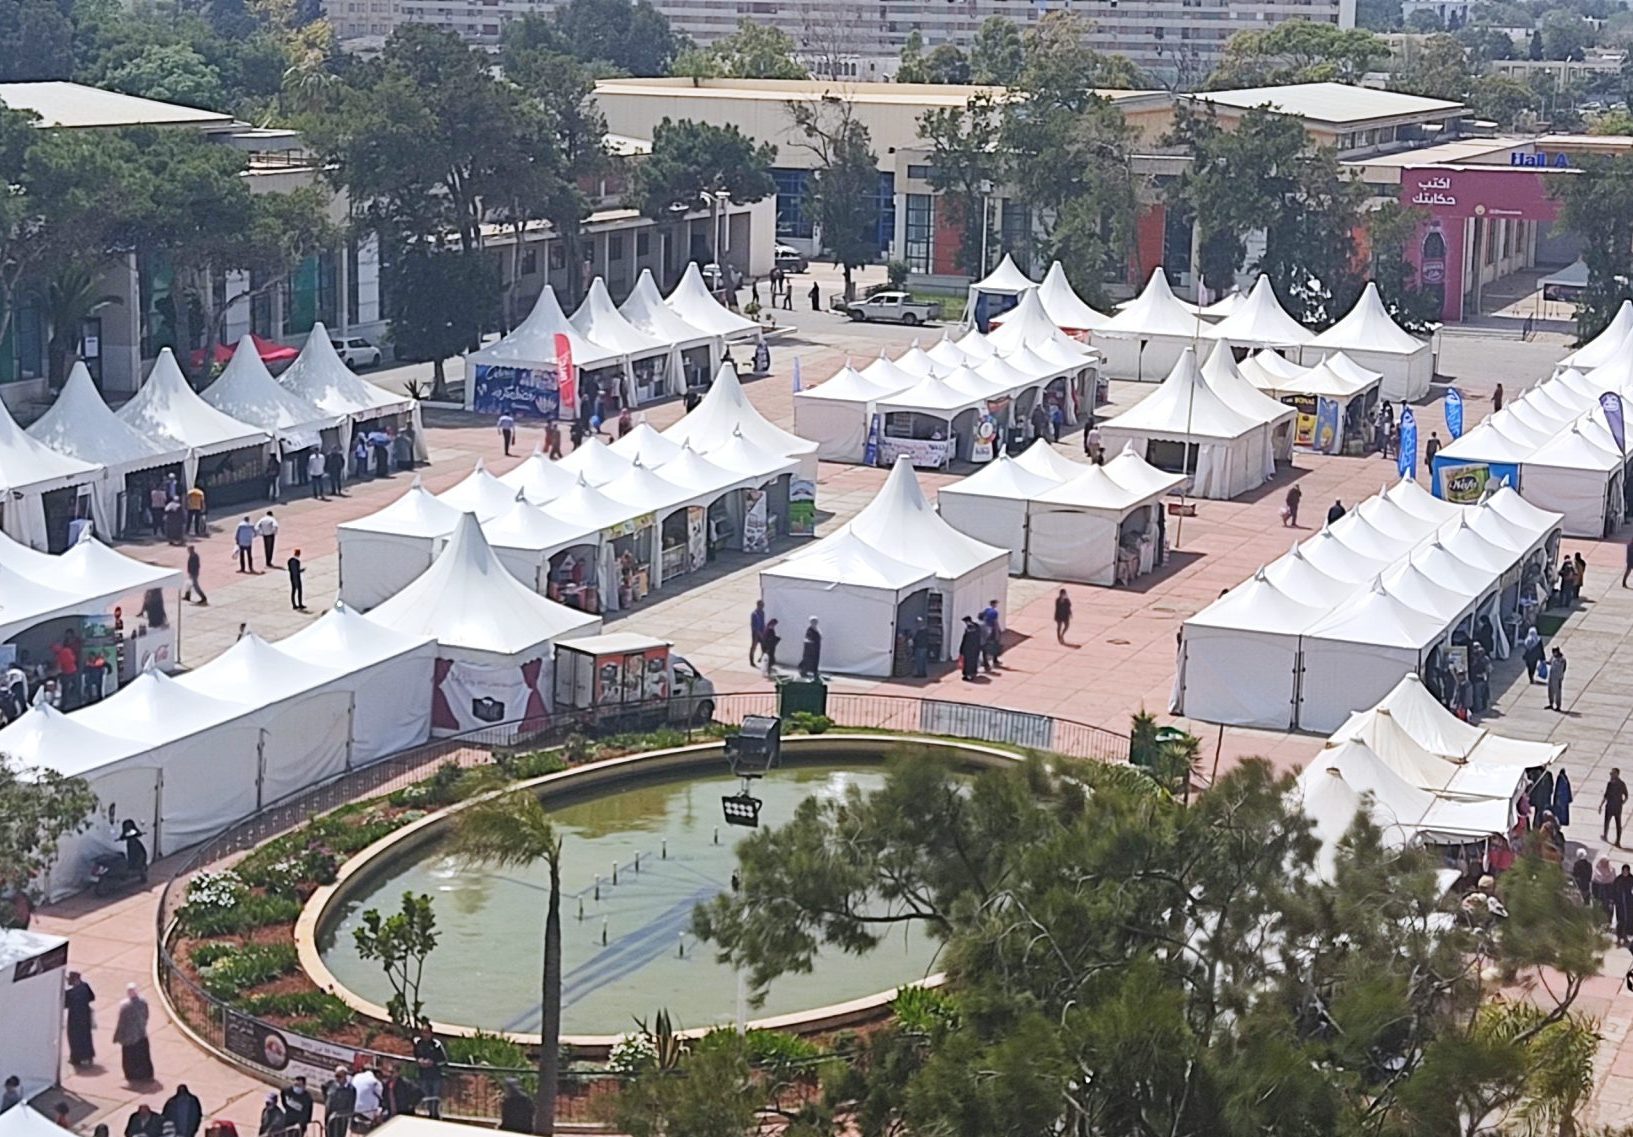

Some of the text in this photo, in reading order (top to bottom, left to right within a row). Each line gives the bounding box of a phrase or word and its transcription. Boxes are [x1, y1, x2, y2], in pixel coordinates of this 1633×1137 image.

[1512, 152, 1569, 168] Hall A
[1418, 177, 1450, 190] اكتب
[1412, 192, 1456, 205] حكايتك
